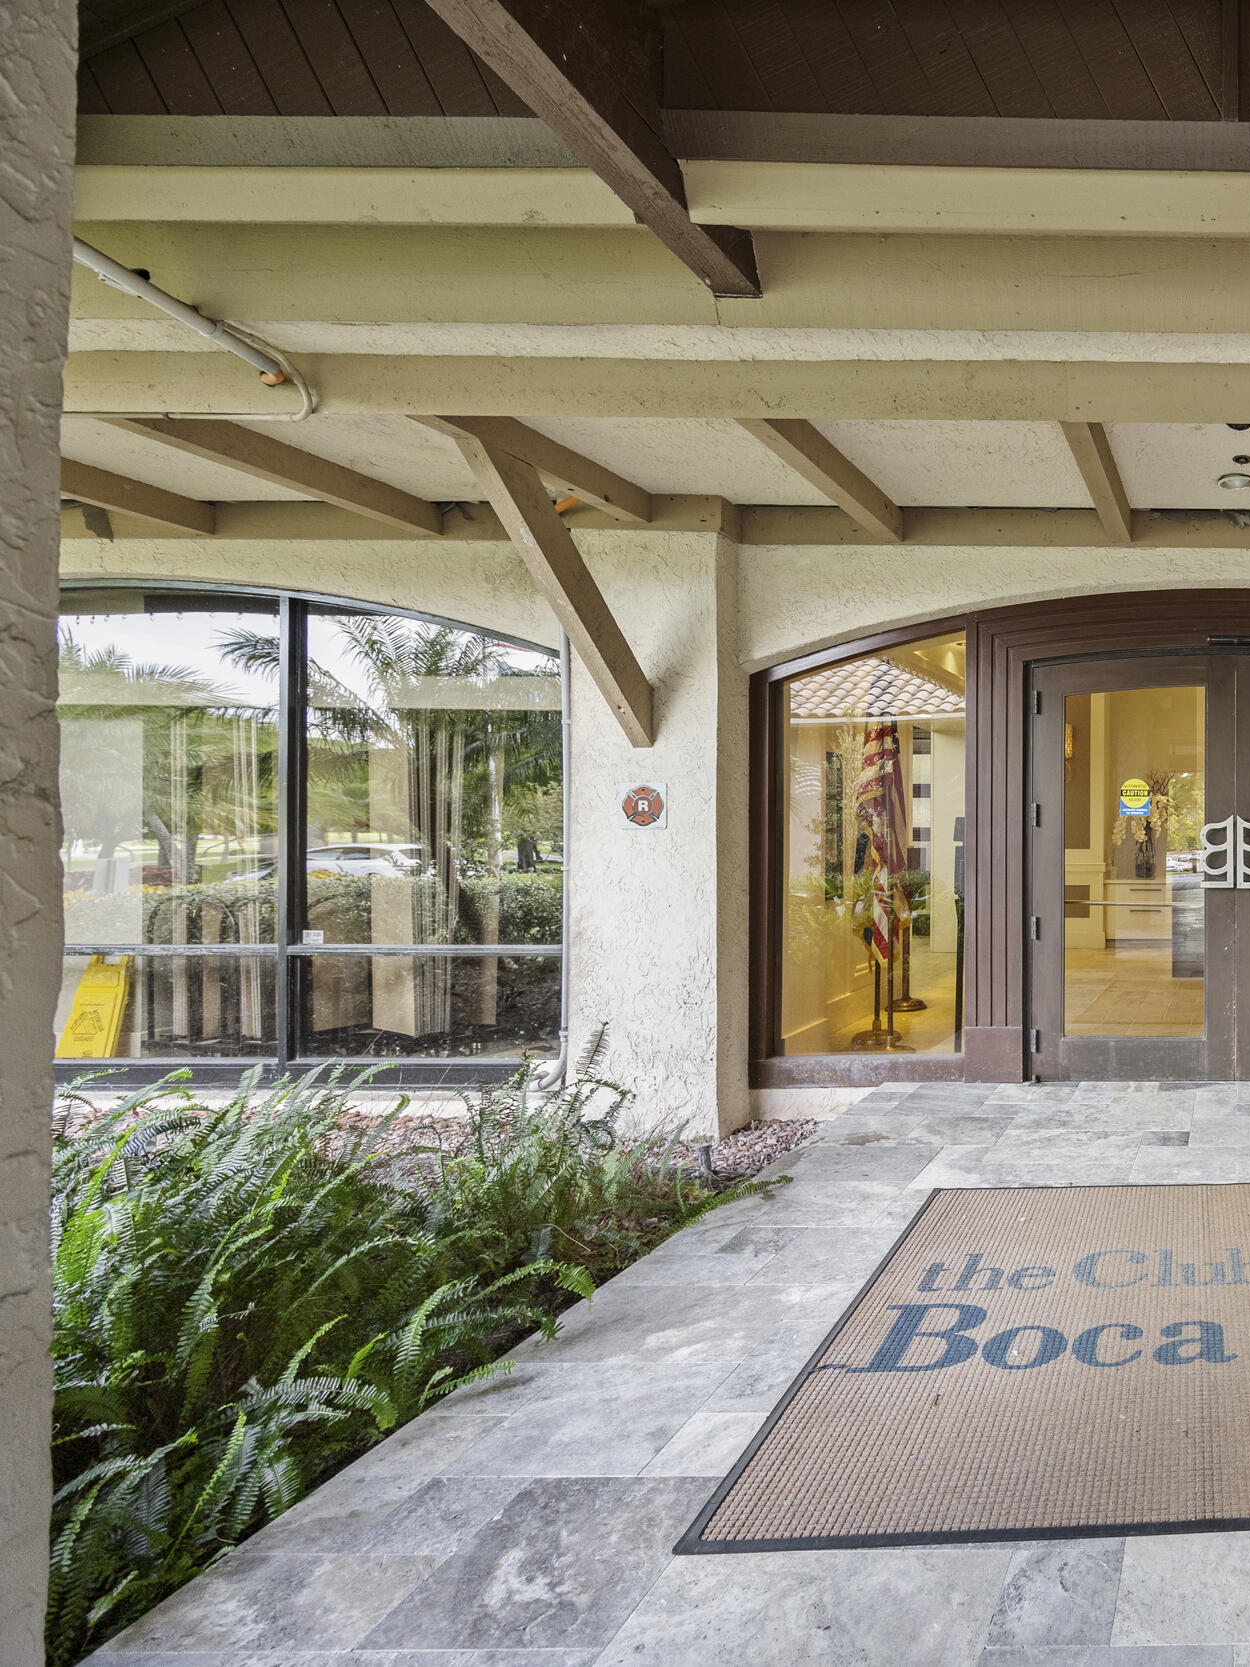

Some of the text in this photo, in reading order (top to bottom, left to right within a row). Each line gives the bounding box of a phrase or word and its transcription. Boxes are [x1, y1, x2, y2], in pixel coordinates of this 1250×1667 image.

[638, 800, 649, 812] R
[917, 1253, 1056, 1293] the
[845, 1303, 1238, 1374] Boca
